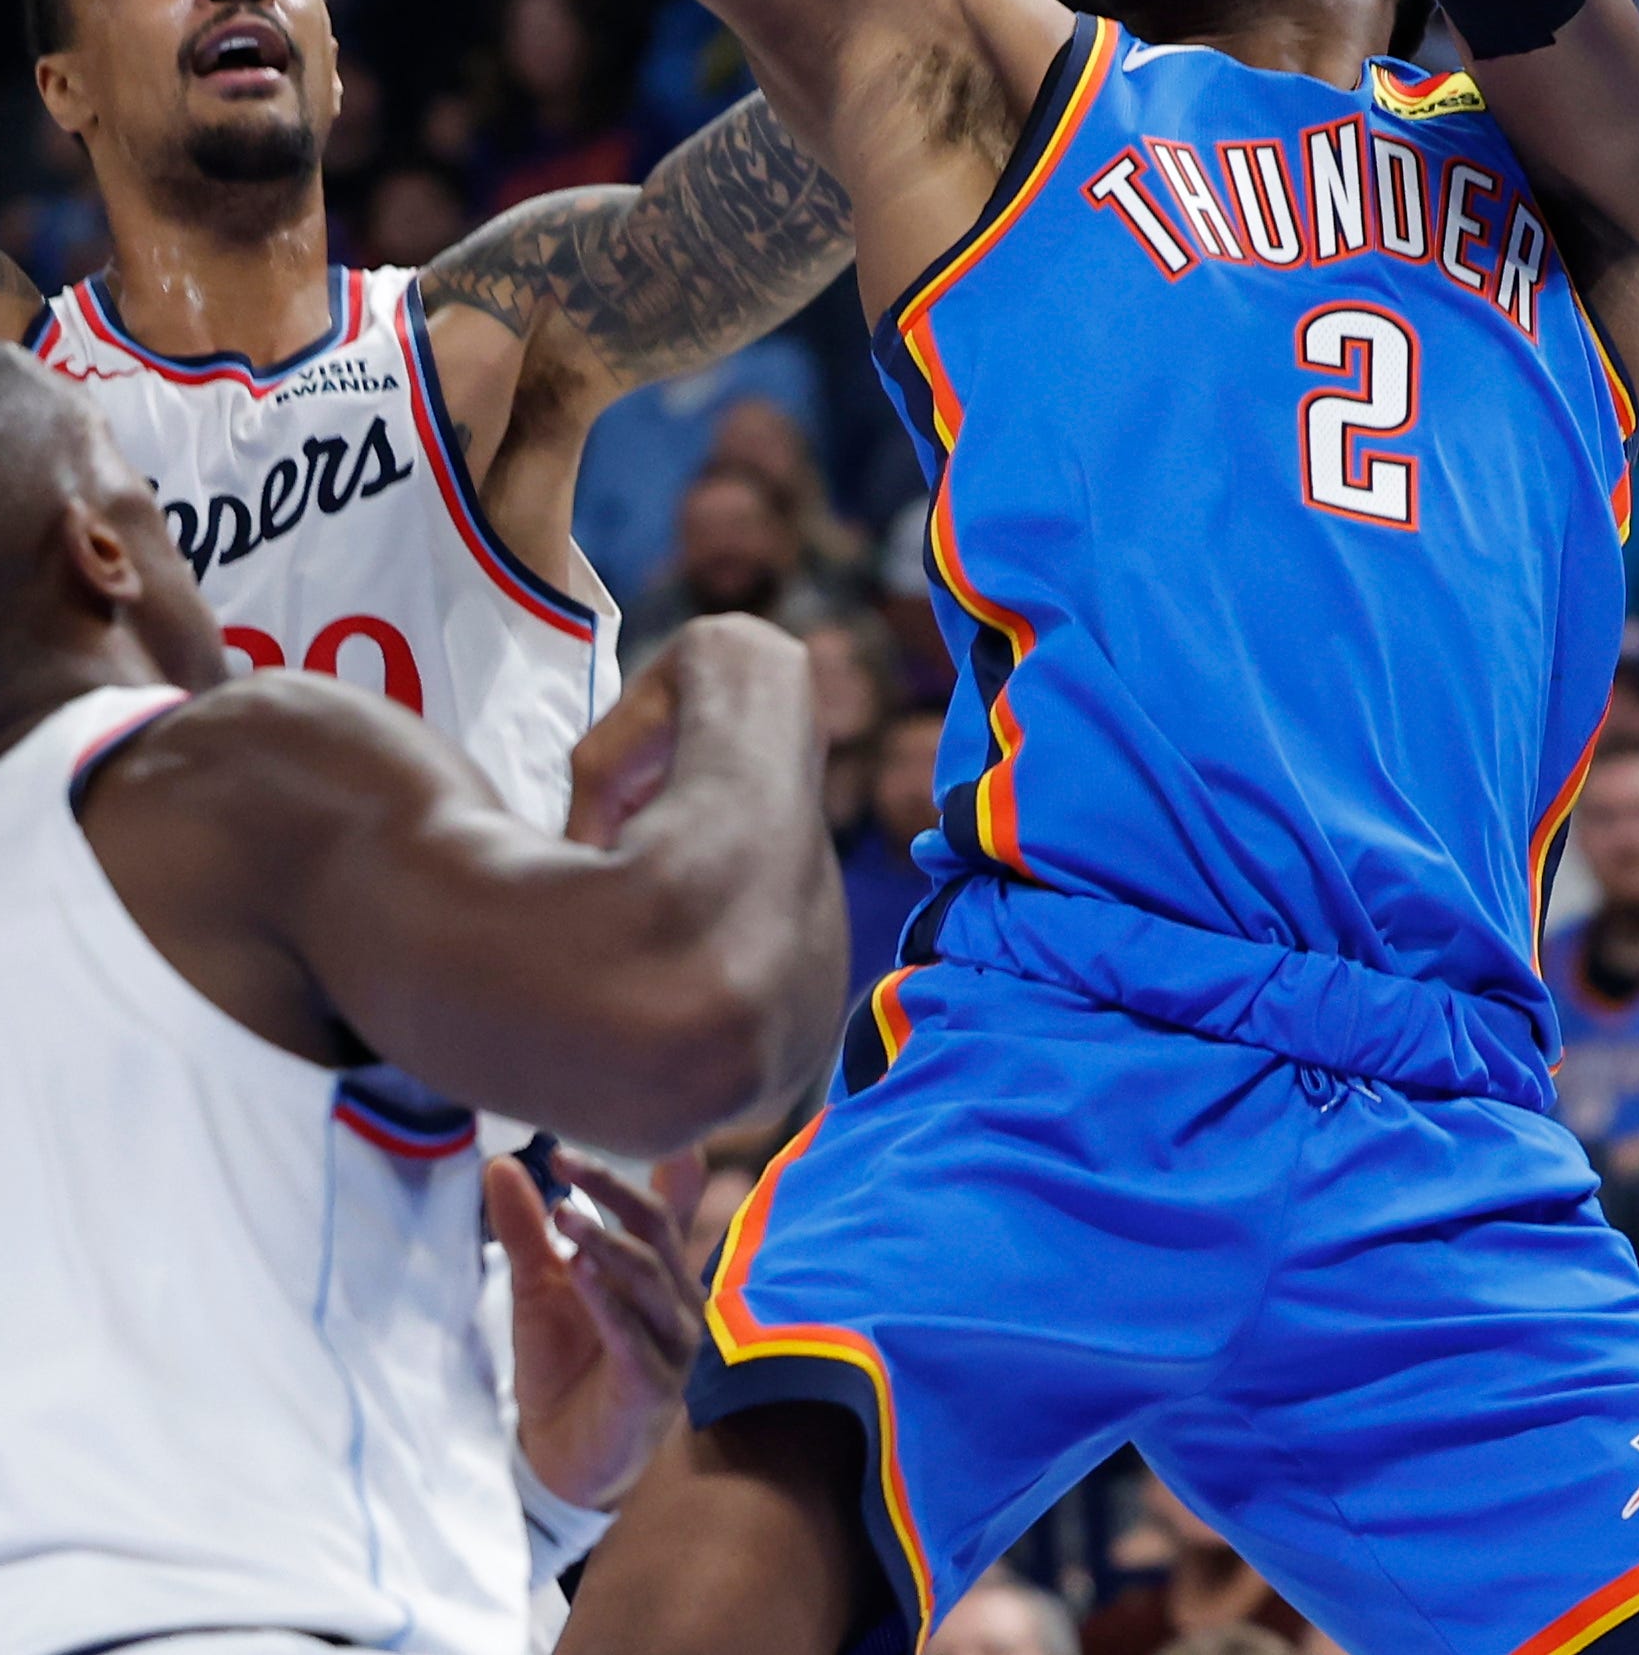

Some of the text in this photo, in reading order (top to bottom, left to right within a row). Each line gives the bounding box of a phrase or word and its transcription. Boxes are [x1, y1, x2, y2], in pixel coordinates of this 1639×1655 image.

[1082, 113, 1550, 342] THUNDER
[298, 357, 367, 381] VISIT
[1295, 301, 1418, 532] 2
